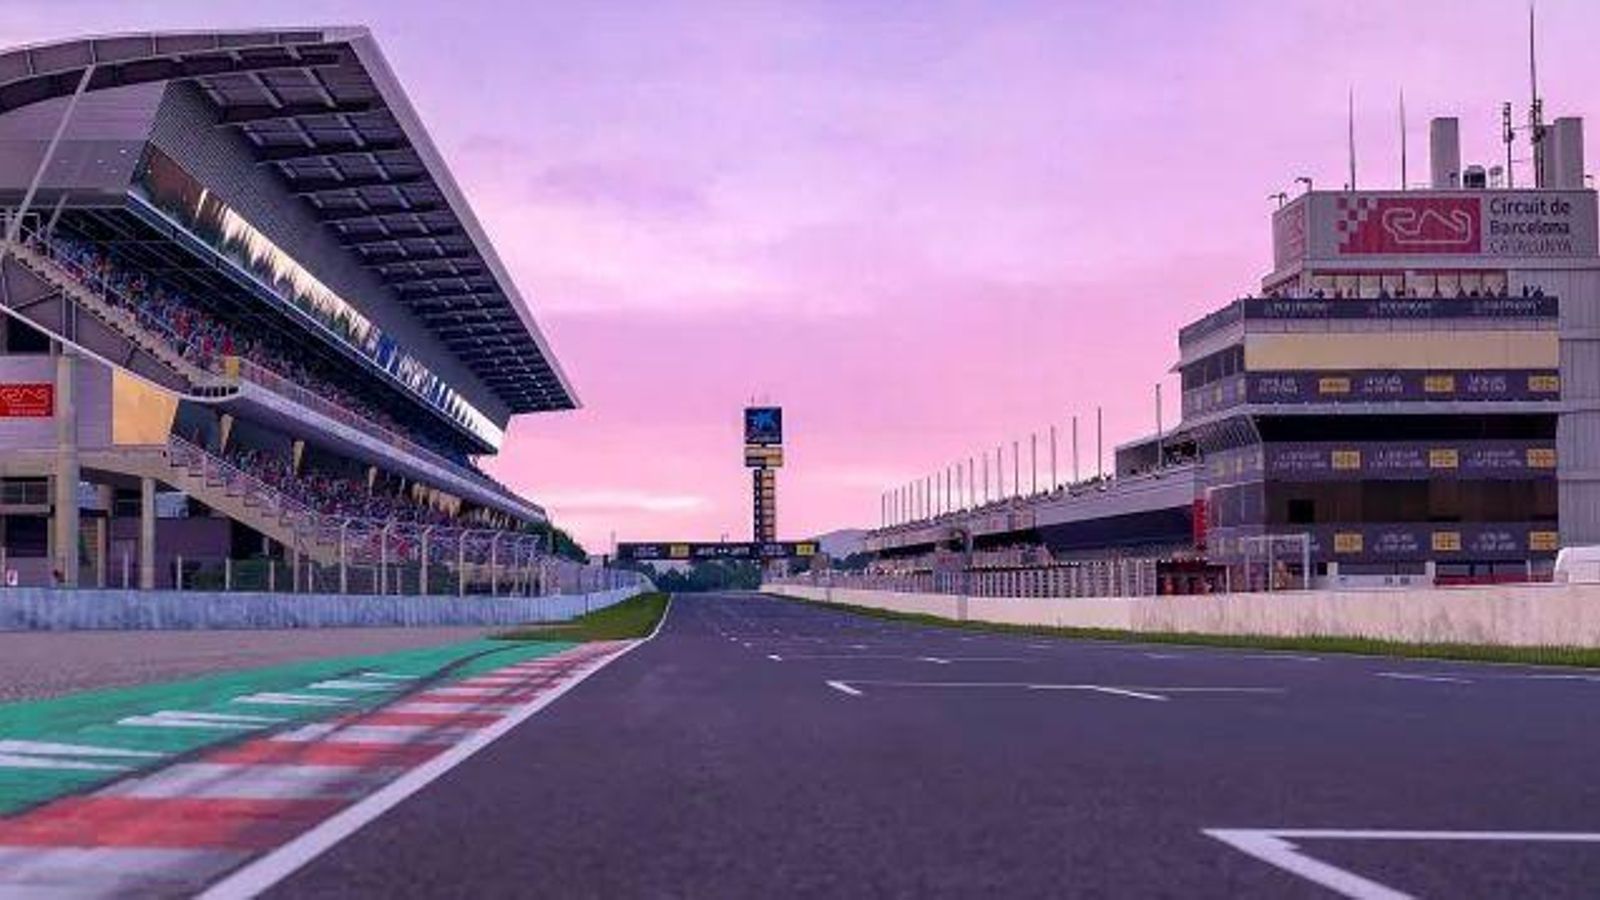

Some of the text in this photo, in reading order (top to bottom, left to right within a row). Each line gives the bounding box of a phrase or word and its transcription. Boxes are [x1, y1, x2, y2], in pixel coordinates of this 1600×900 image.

[1490, 197, 1570, 215] Circuit de
[1490, 220, 1570, 235] Barcelona
